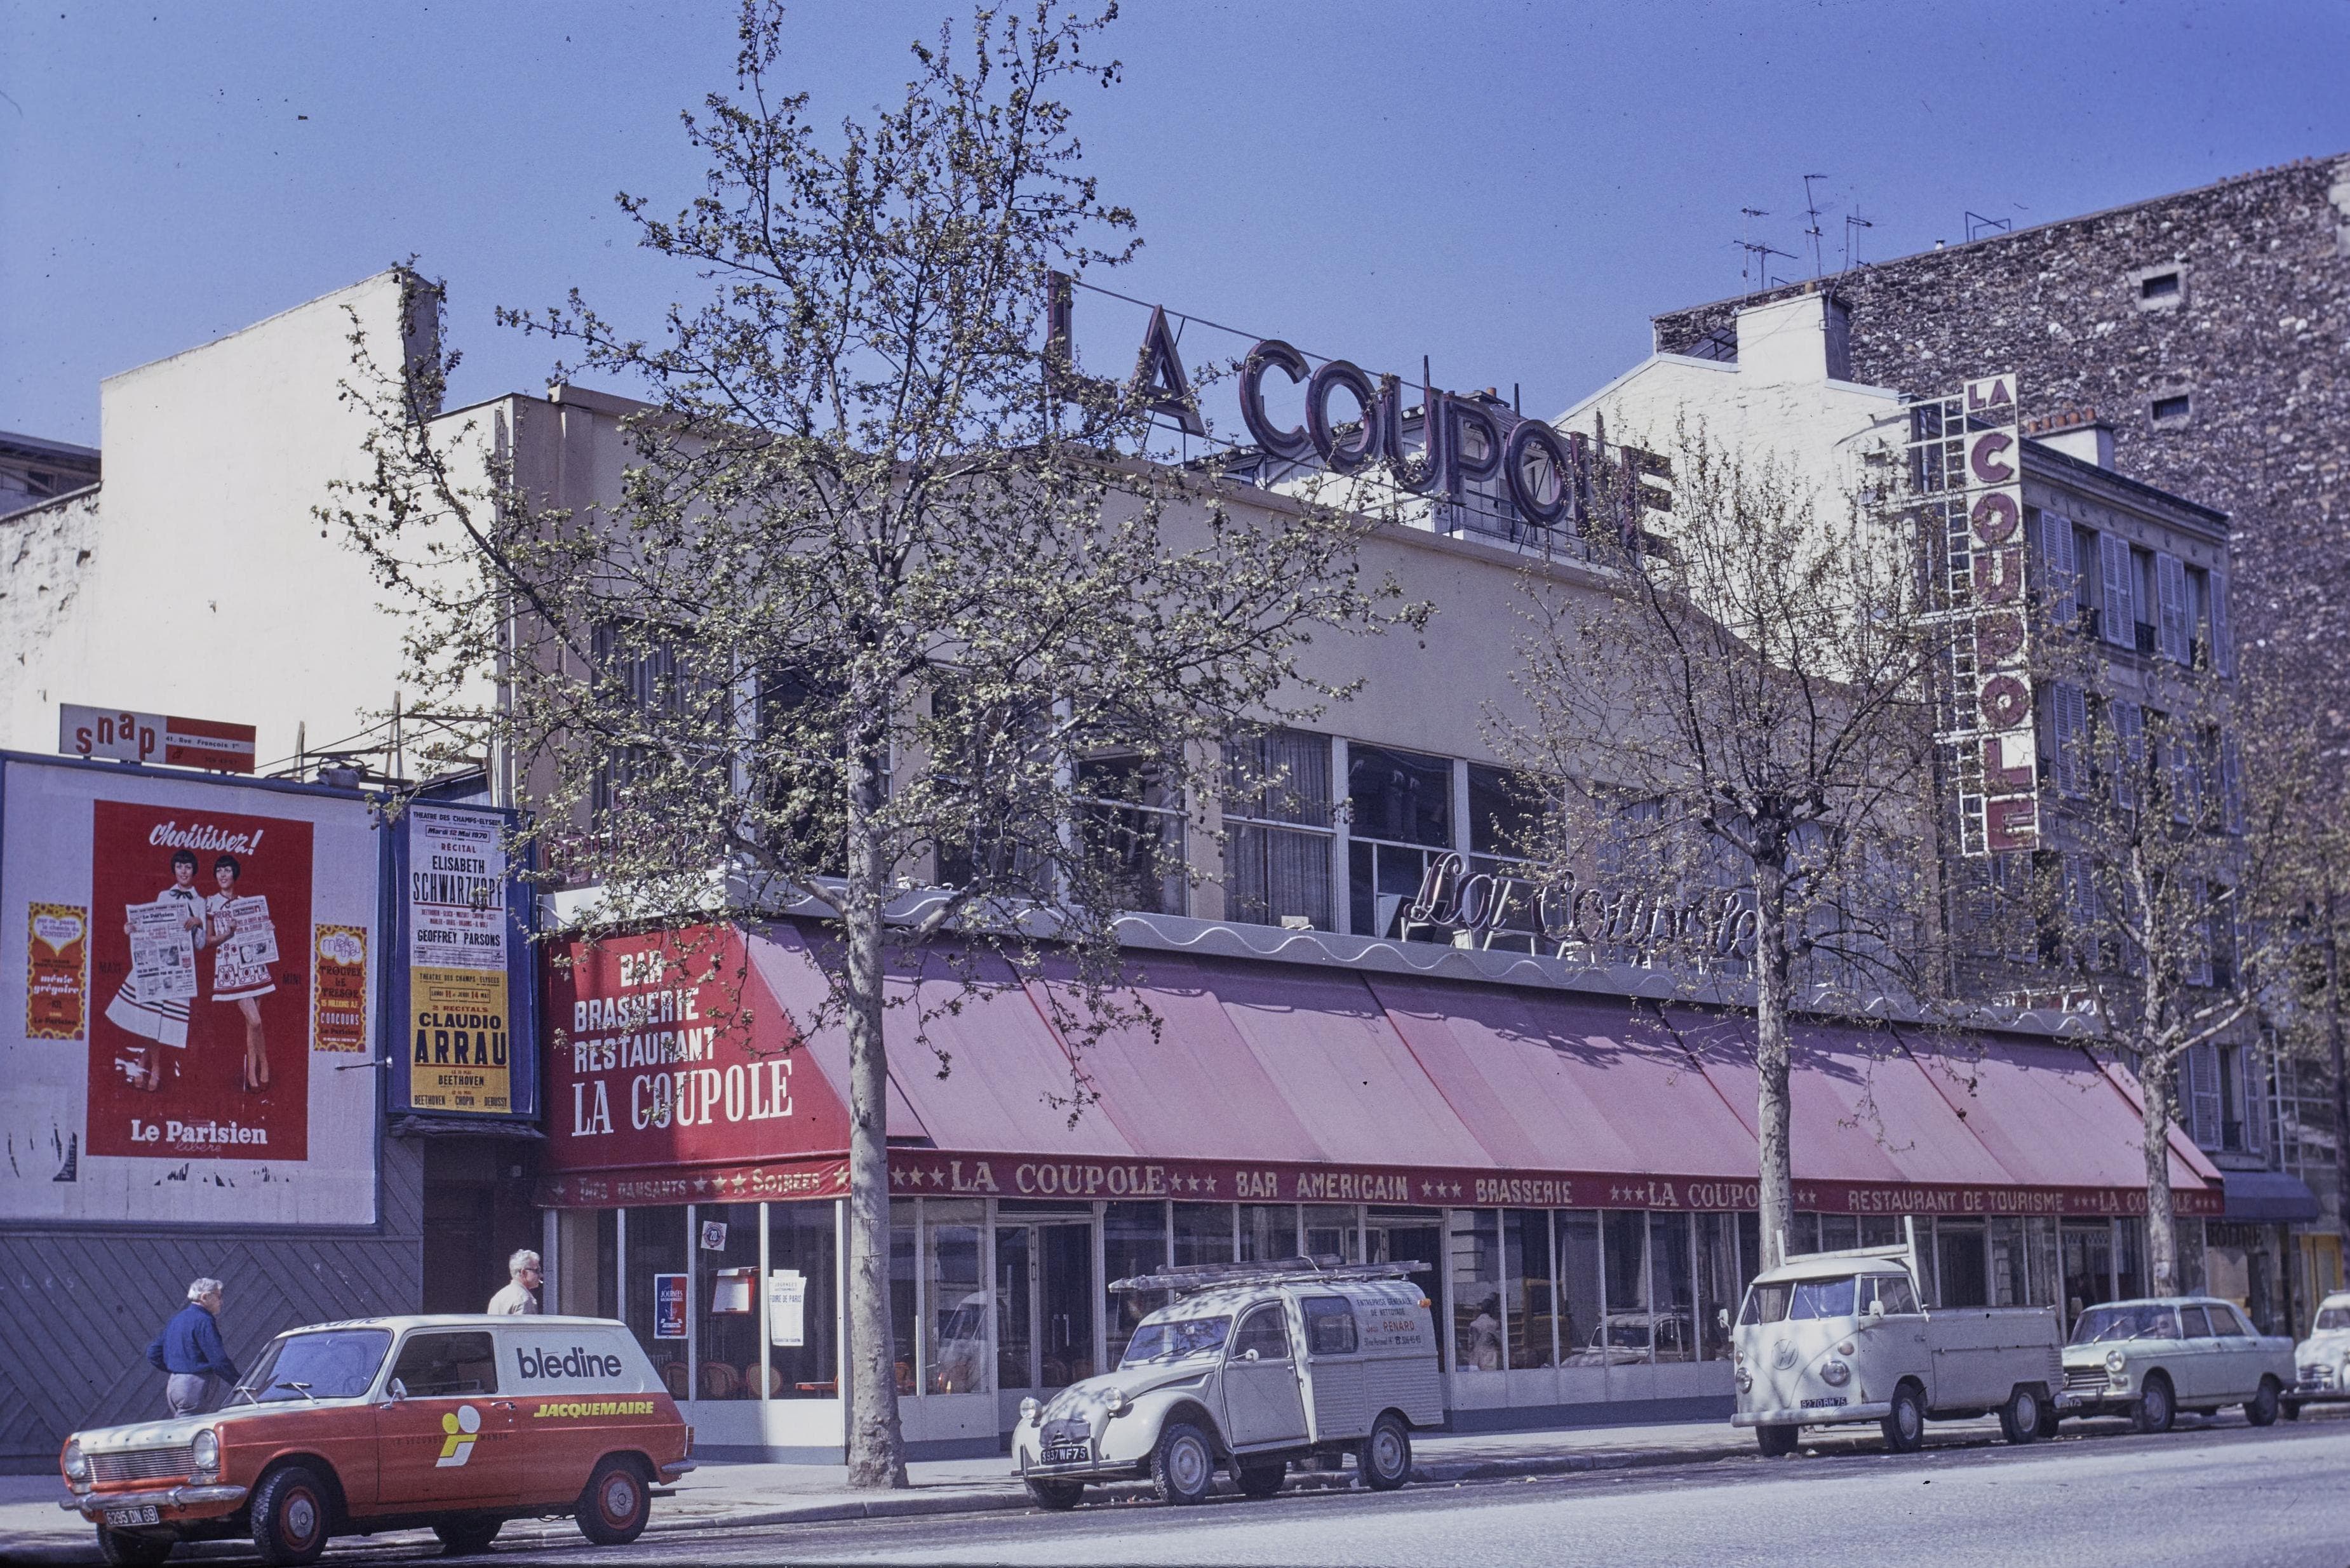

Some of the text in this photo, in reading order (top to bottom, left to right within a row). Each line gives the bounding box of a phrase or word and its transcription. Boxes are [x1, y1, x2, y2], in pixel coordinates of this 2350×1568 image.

[1968, 379, 2012, 410] LA
[1047, 270, 1678, 559] LA COUPOLE
[1970, 432, 2038, 851] COUPOLE
[76, 713, 155, 761] snap
[197, 739, 229, 748] François
[432, 855, 485, 874] ELISABETH
[413, 872, 502, 907] SCHWARZKOPF
[1402, 851, 1507, 930] La
[417, 929, 500, 946] GEOFFREY PARSONS
[420, 973, 441, 981] THEATRE
[621, 951, 662, 987] BAR
[335, 977, 346, 987] LE
[321, 1012, 359, 1026] CONCOURS
[419, 1012, 501, 1029] CLAUDIO
[415, 1029, 506, 1065] ARRAU
[574, 1026, 716, 1073] RESTAURANT
[438, 1075, 484, 1085] BEETHOVEN
[414, 1095, 507, 1107] BEETHOVEN CHOPIN DEBUSSY
[572, 1059, 793, 1137] LA COUPOLE
[131, 1120, 268, 1144] Le Parisien
[950, 1160, 1167, 1195] LA COUPOLE
[1235, 1170, 1409, 1202] BAR AMERICAIN
[1475, 1179, 1573, 1205] BRASSERIE
[1648, 1181, 1759, 1207] LA COUPO
[1848, 1189, 2064, 1212] RESTAURANT DE TOURISME
[2099, 1191, 2192, 1212] LA COLE
[1357, 1298, 1385, 1306] ENTREPRISE
[1383, 1320, 1415, 1332] RENARD
[534, 1401, 654, 1418] JACQUEMAIRE
[107, 1510, 128, 1525] 6295
[143, 1508, 156, 1522] 69
